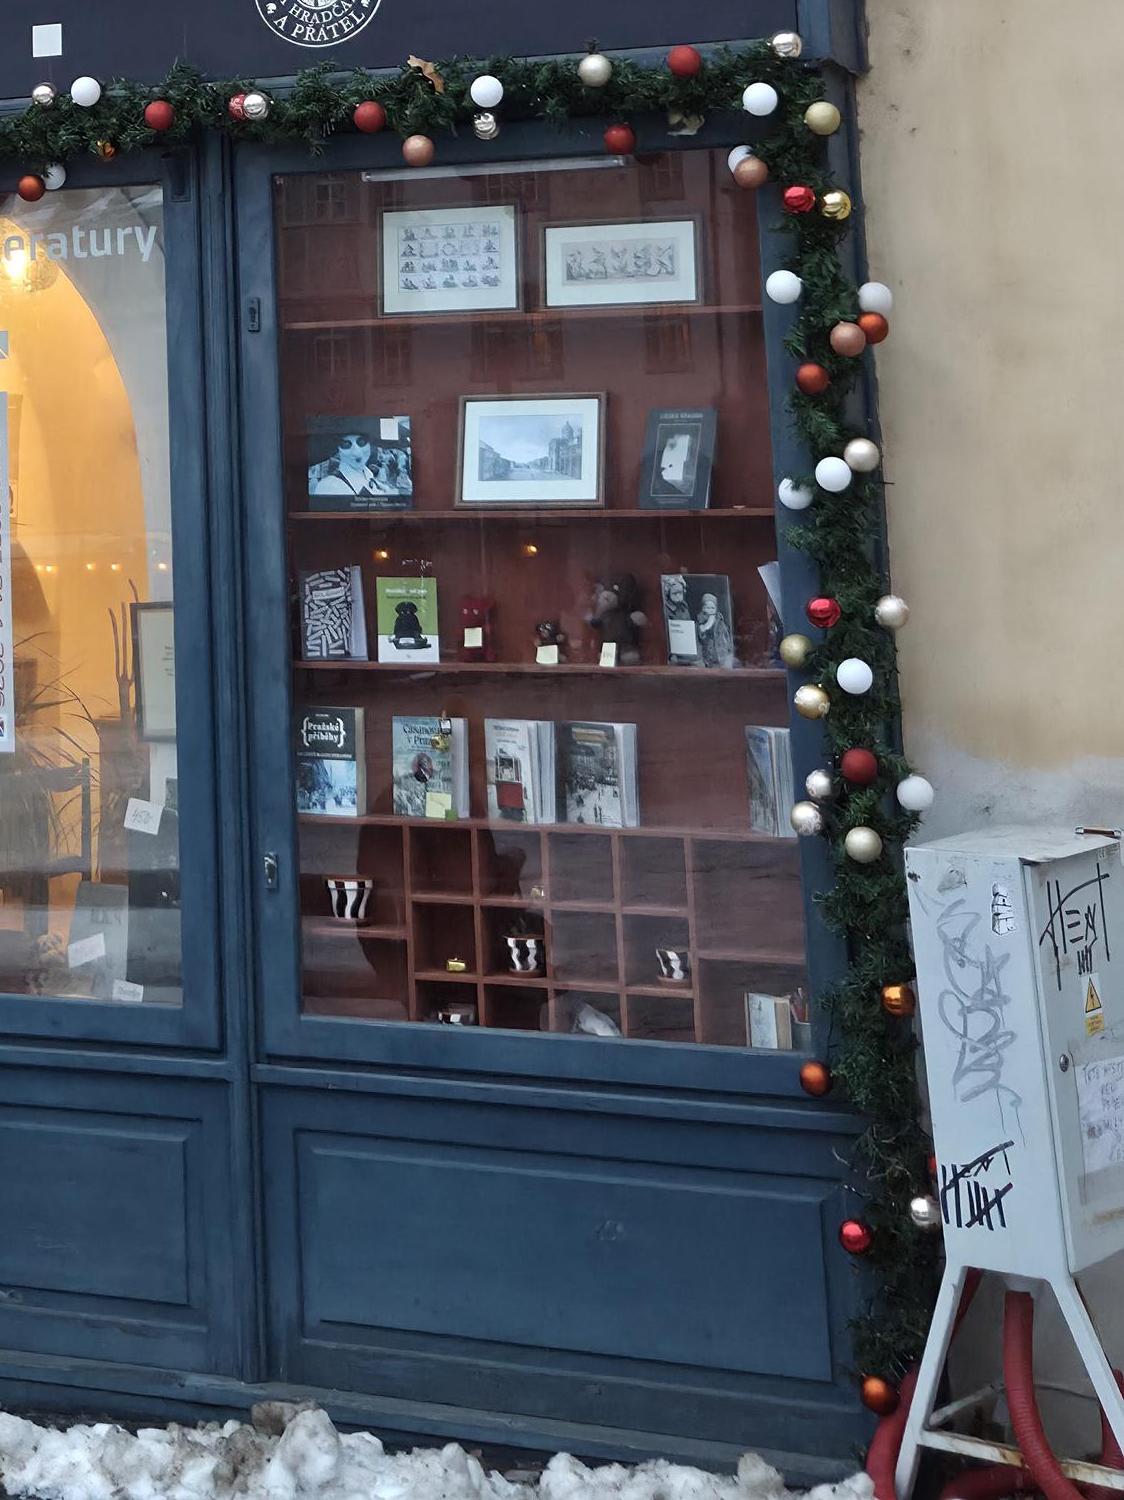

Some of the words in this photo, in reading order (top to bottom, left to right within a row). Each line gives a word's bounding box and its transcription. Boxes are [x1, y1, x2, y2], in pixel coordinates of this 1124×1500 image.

[274, 15, 288, 31] A
[291, 11, 365, 42] PŘÁTEL
[308, 722, 339, 731] Pražské
